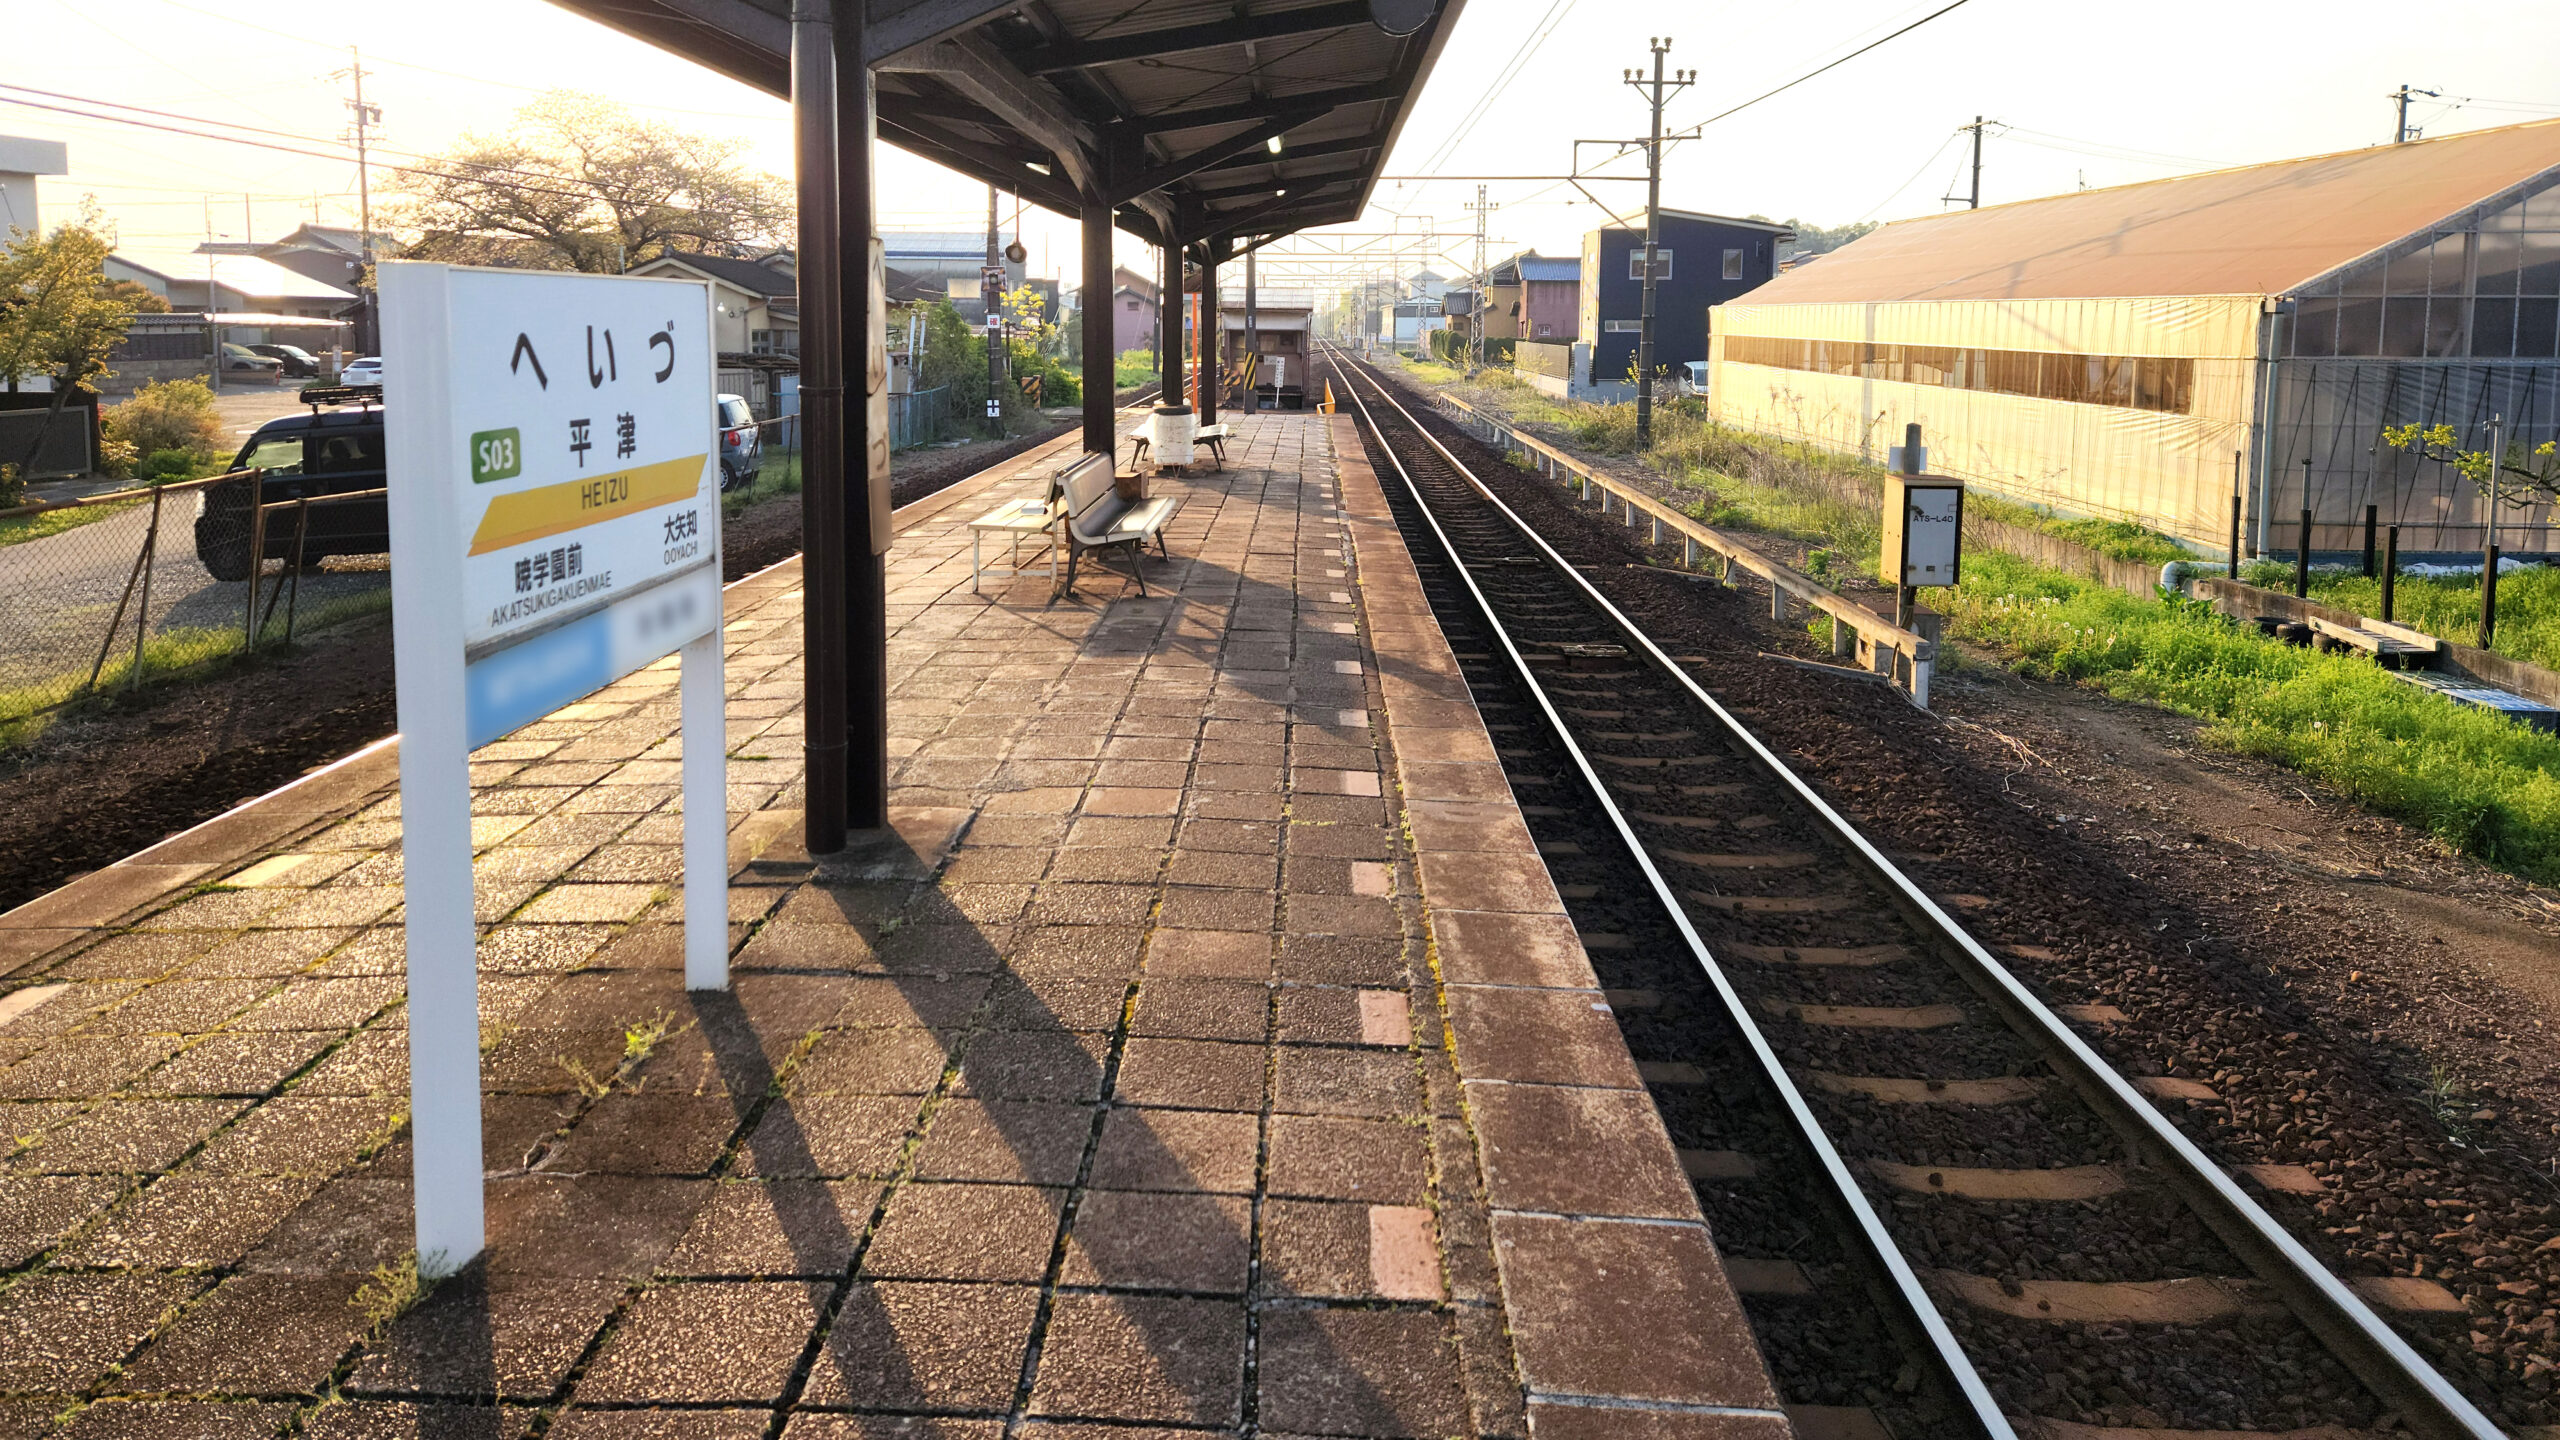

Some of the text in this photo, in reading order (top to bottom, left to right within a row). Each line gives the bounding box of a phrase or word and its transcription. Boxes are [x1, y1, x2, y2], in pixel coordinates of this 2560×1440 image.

[510, 319, 675, 392] へいづ
[479, 437, 515, 474] S03
[569, 411, 636, 468] 平津
[581, 475, 629, 510] HEIZU
[663, 509, 698, 546] 大矢知
[514, 542, 583, 594] 暁学園前
[663, 540, 698, 566] OOYACHI
[491, 570, 613, 628] AKATSUKIGAKUENMAE
